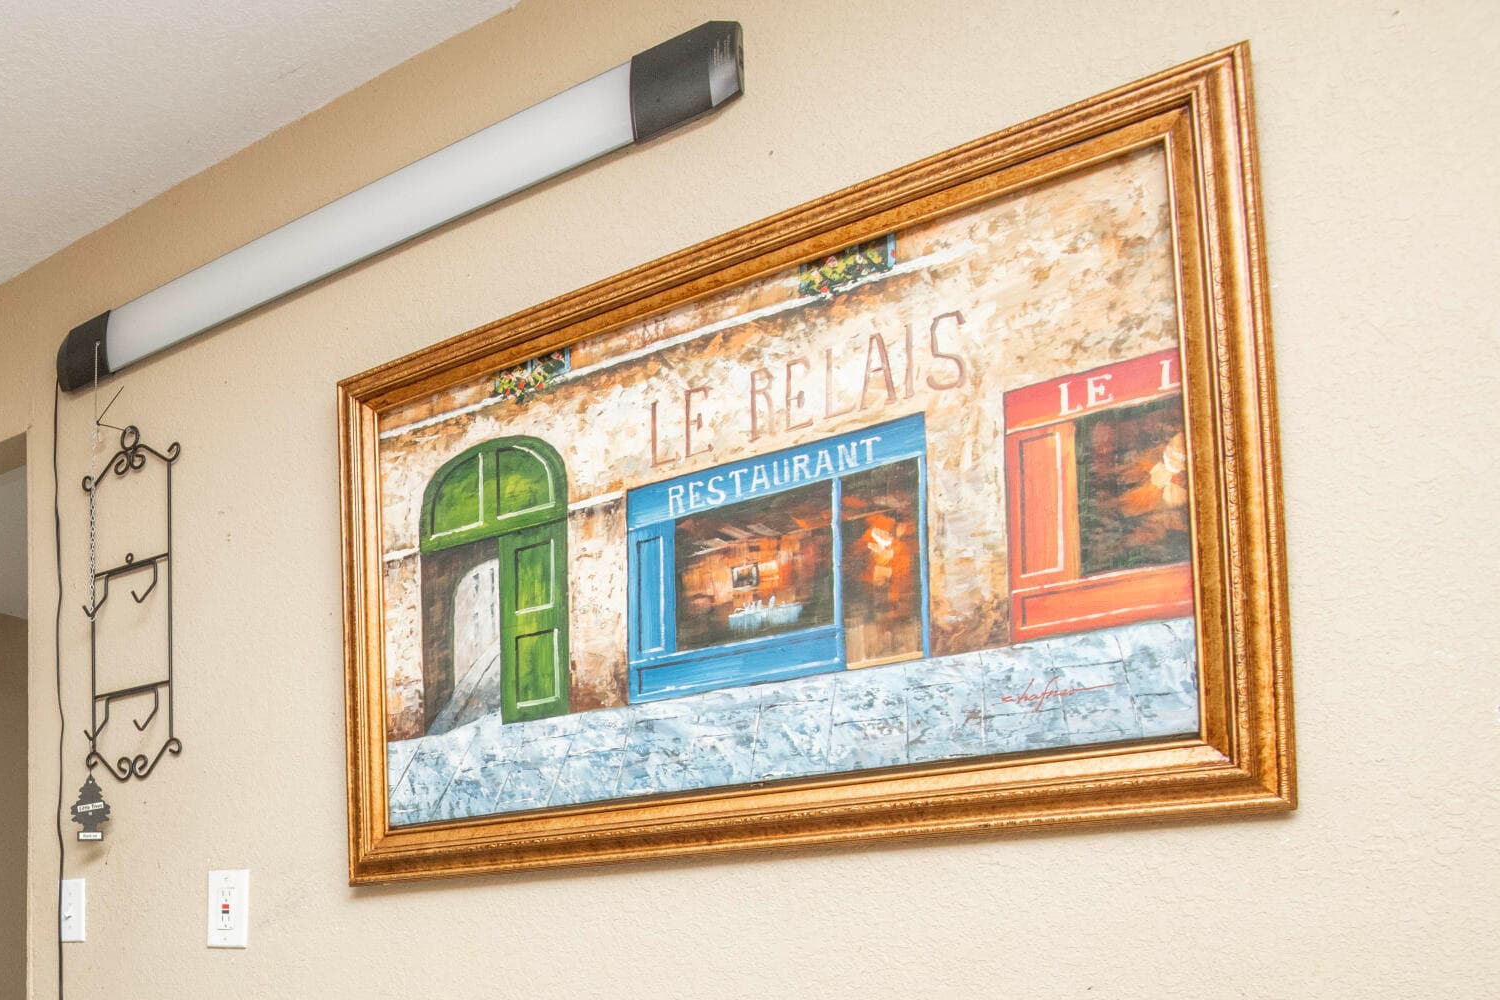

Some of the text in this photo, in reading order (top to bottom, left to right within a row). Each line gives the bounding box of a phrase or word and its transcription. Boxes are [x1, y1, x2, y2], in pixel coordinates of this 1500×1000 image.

[651, 310, 967, 468] LE RELAIS
[1057, 373, 1114, 417] LE
[667, 435, 882, 513] RESTAURANT
